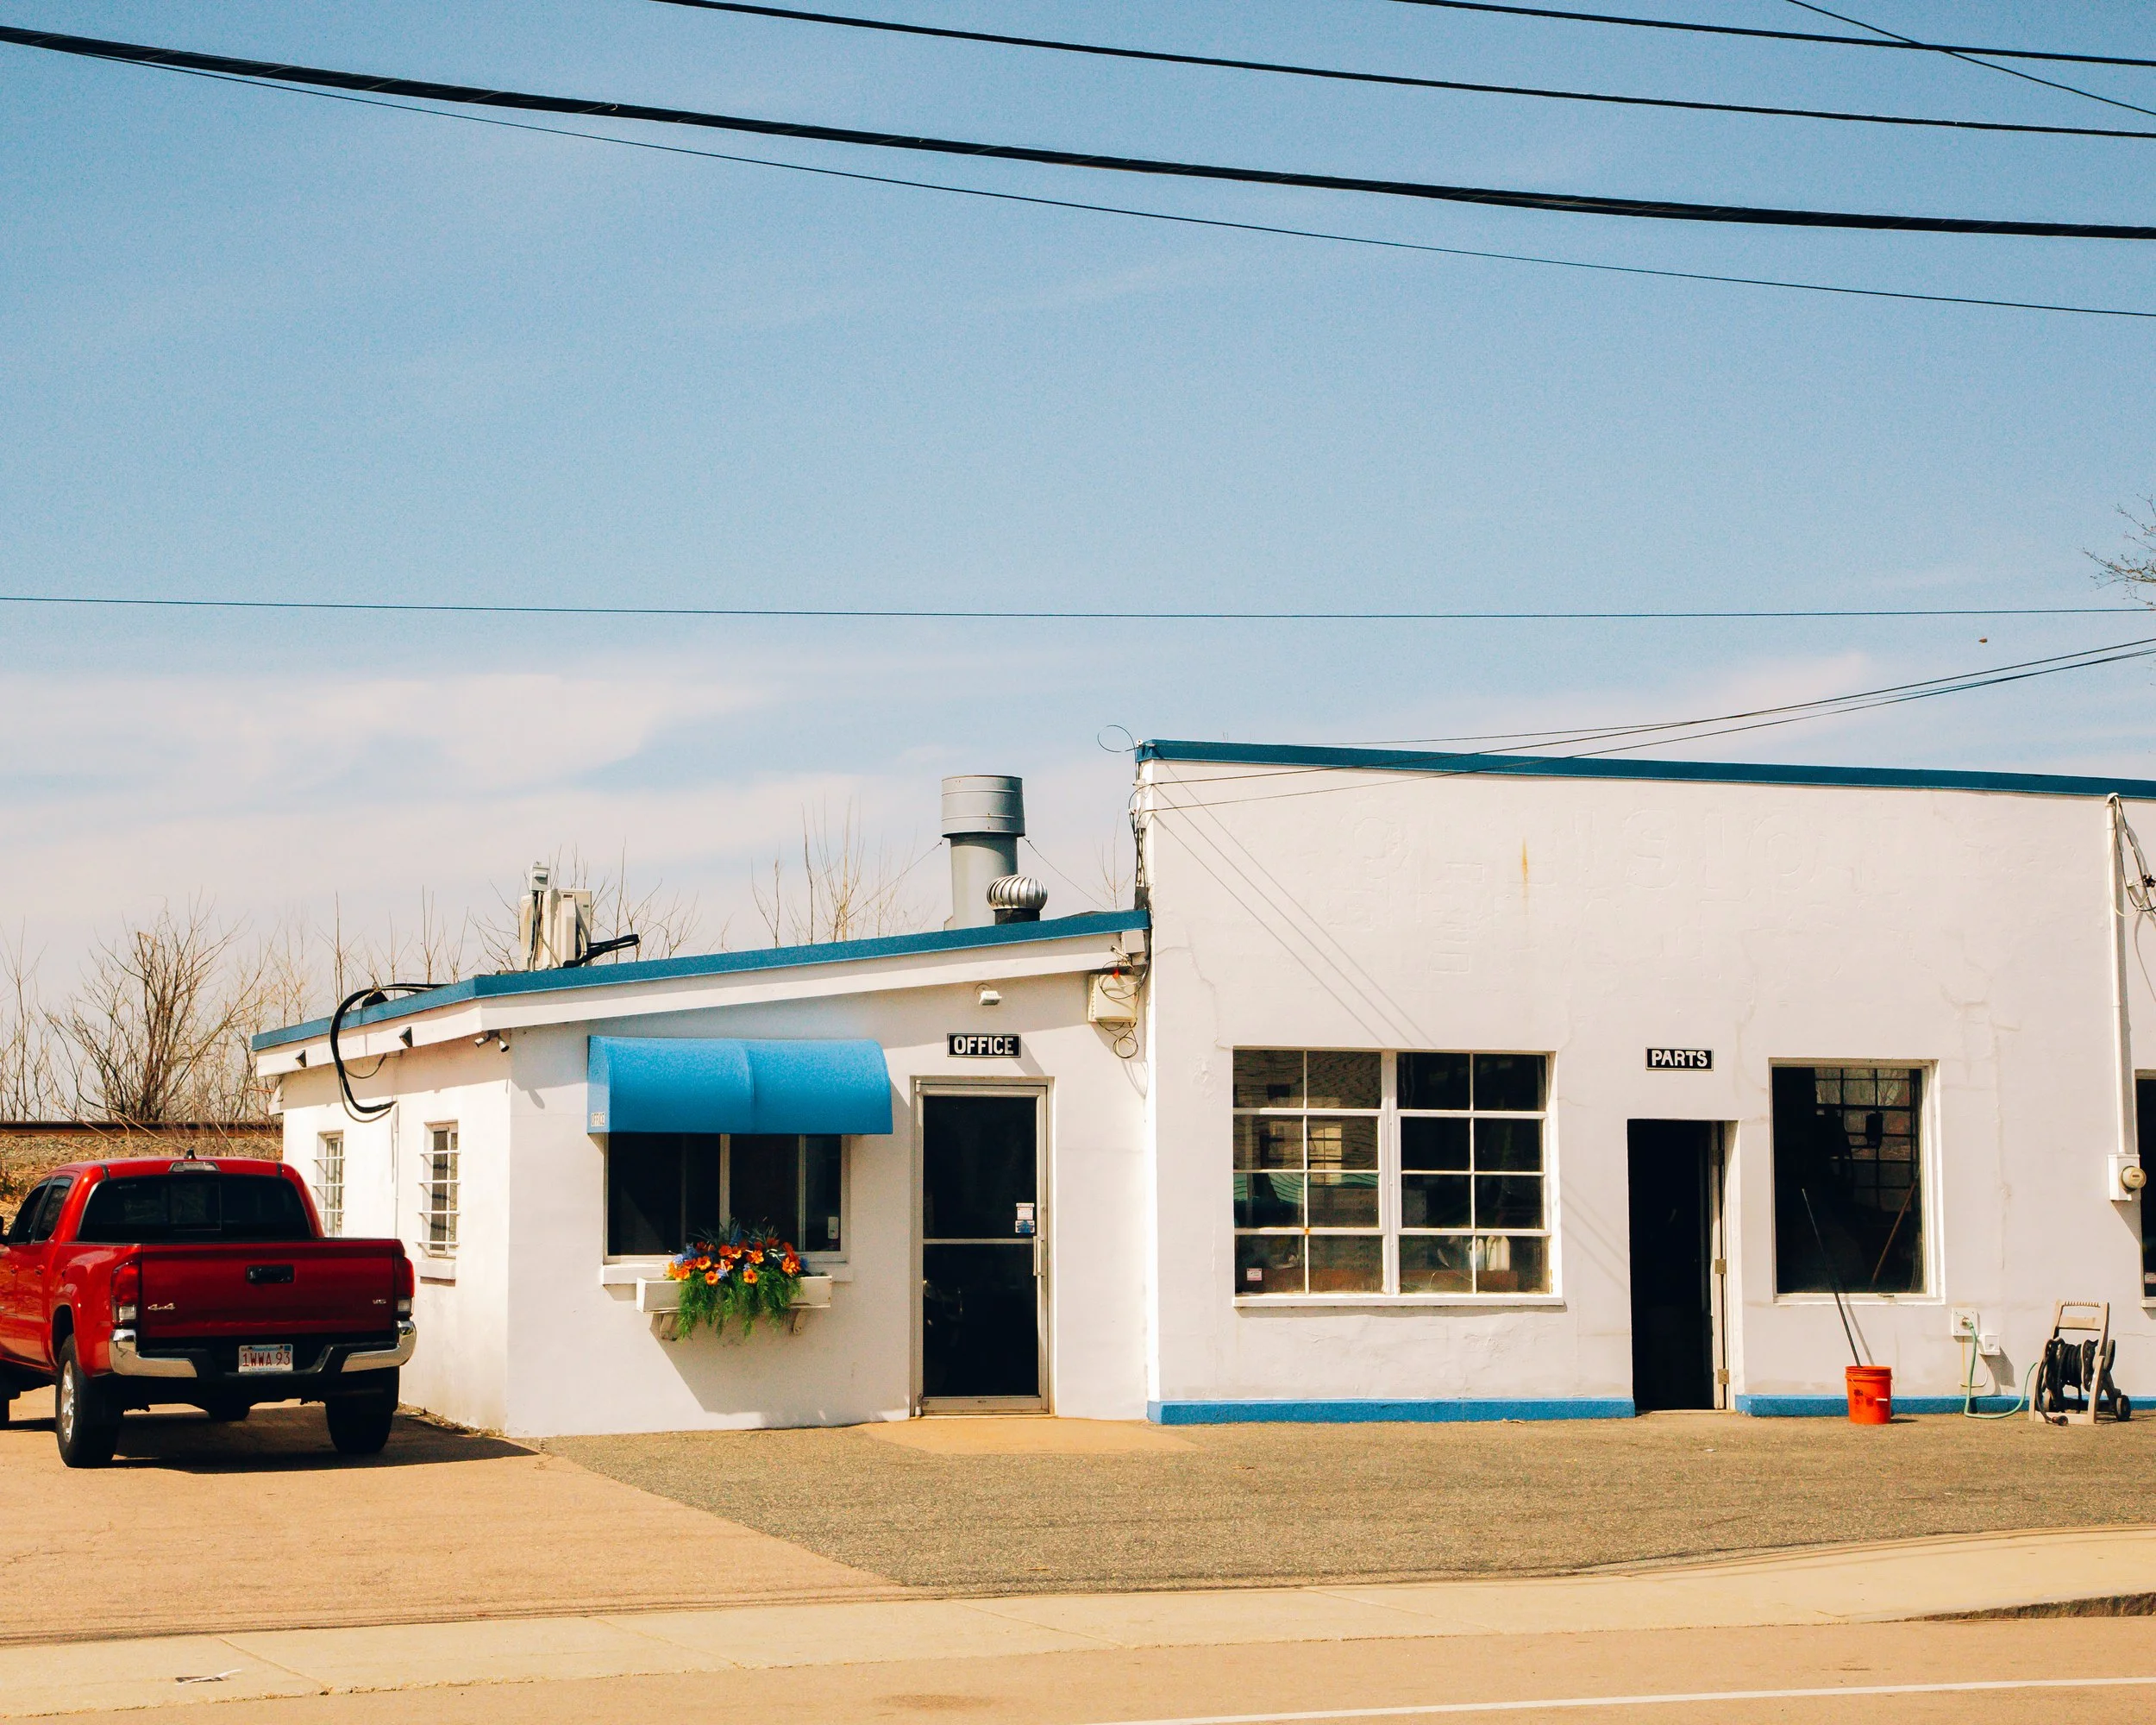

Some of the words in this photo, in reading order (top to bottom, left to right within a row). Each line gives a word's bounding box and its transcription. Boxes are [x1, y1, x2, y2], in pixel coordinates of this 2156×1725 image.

[954, 1036, 1014, 1055] OFFICE
[1651, 1050, 1708, 1067] PARTS
[276, 1352, 291, 1366] 93
